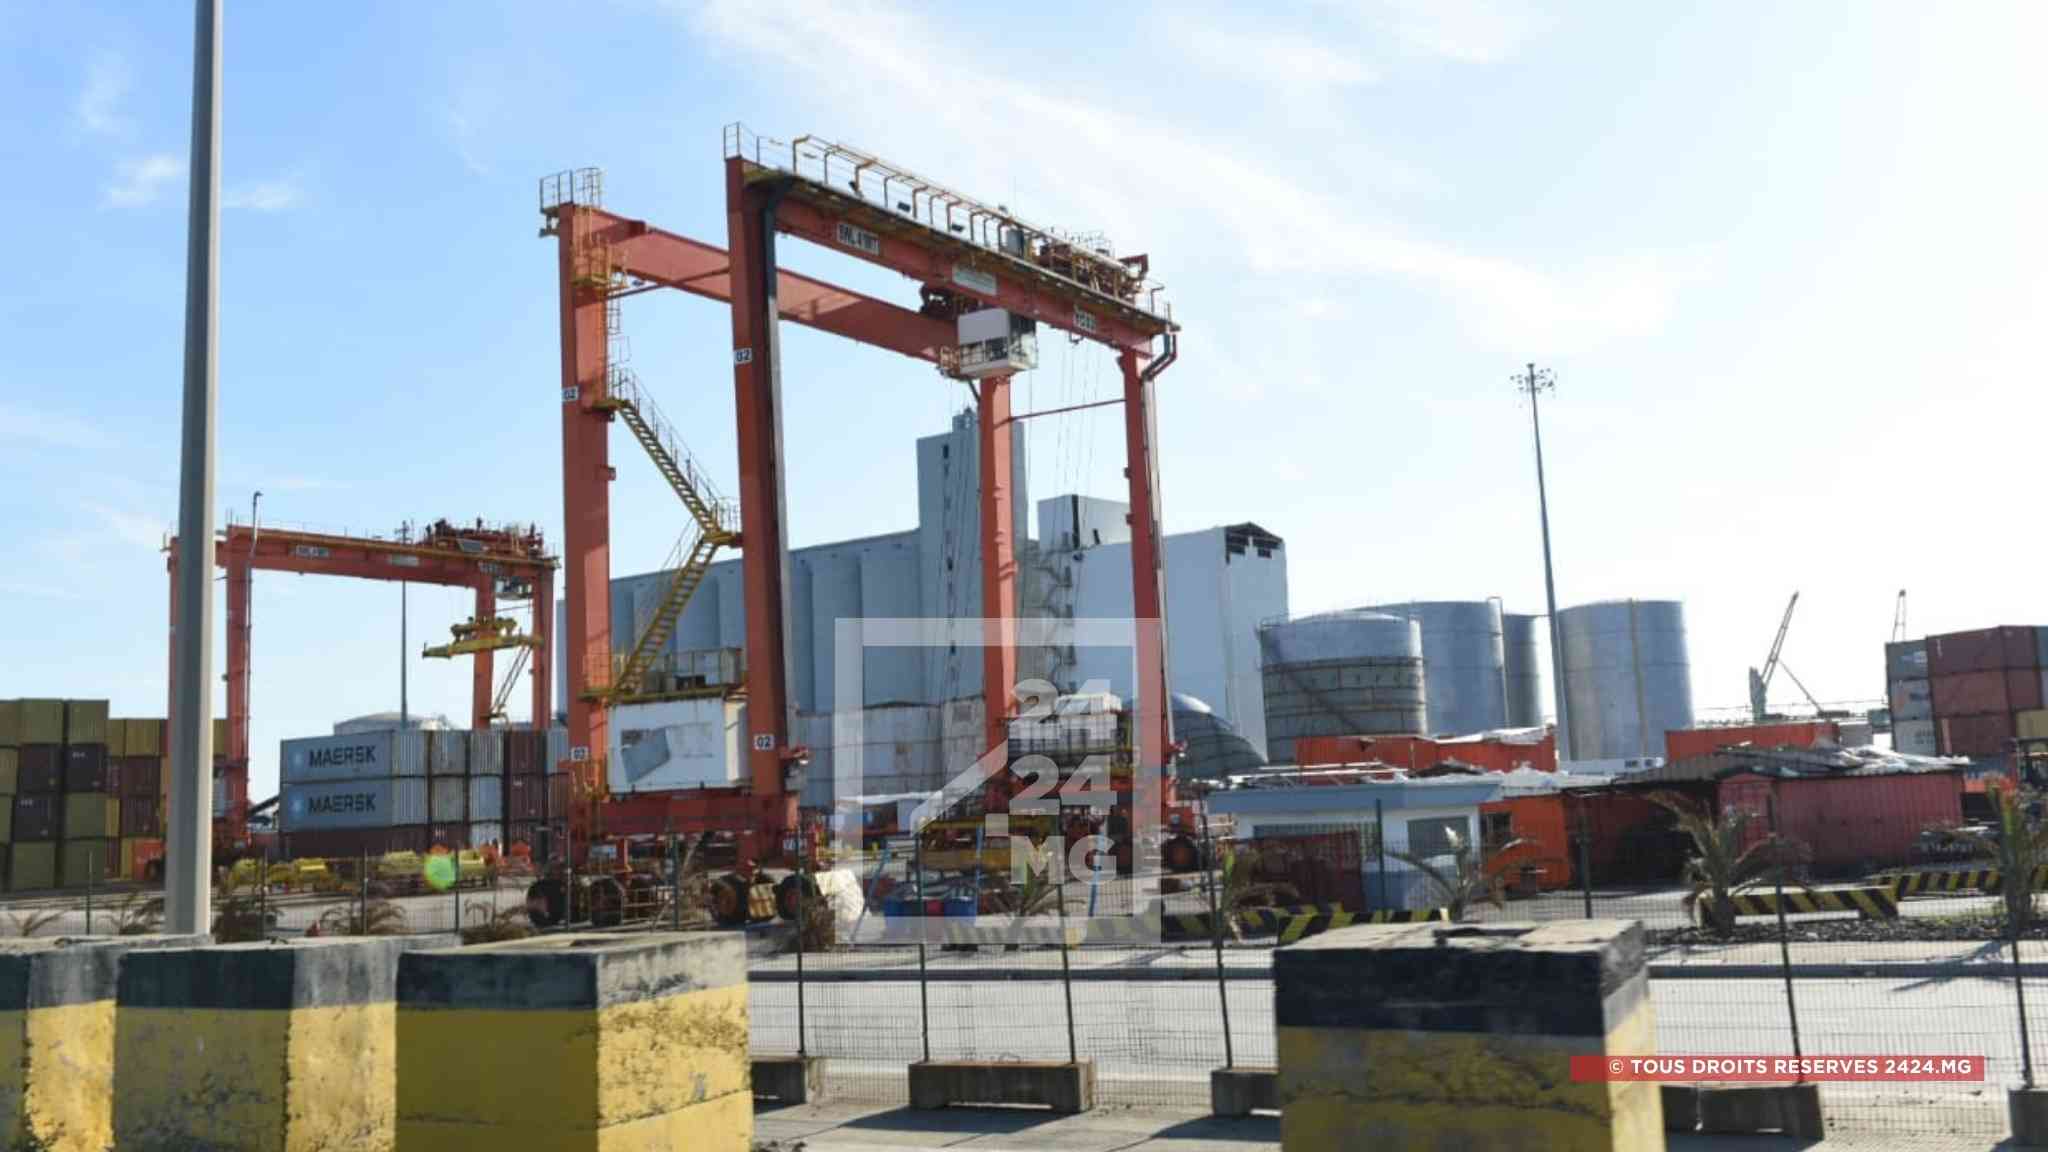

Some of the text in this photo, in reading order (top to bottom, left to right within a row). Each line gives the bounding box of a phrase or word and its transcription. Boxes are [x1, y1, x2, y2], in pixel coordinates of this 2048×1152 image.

[736, 349, 751, 361] 02
[756, 735, 771, 749] 02
[308, 745, 377, 768] MAERSK
[308, 792, 377, 816] MAERSK
